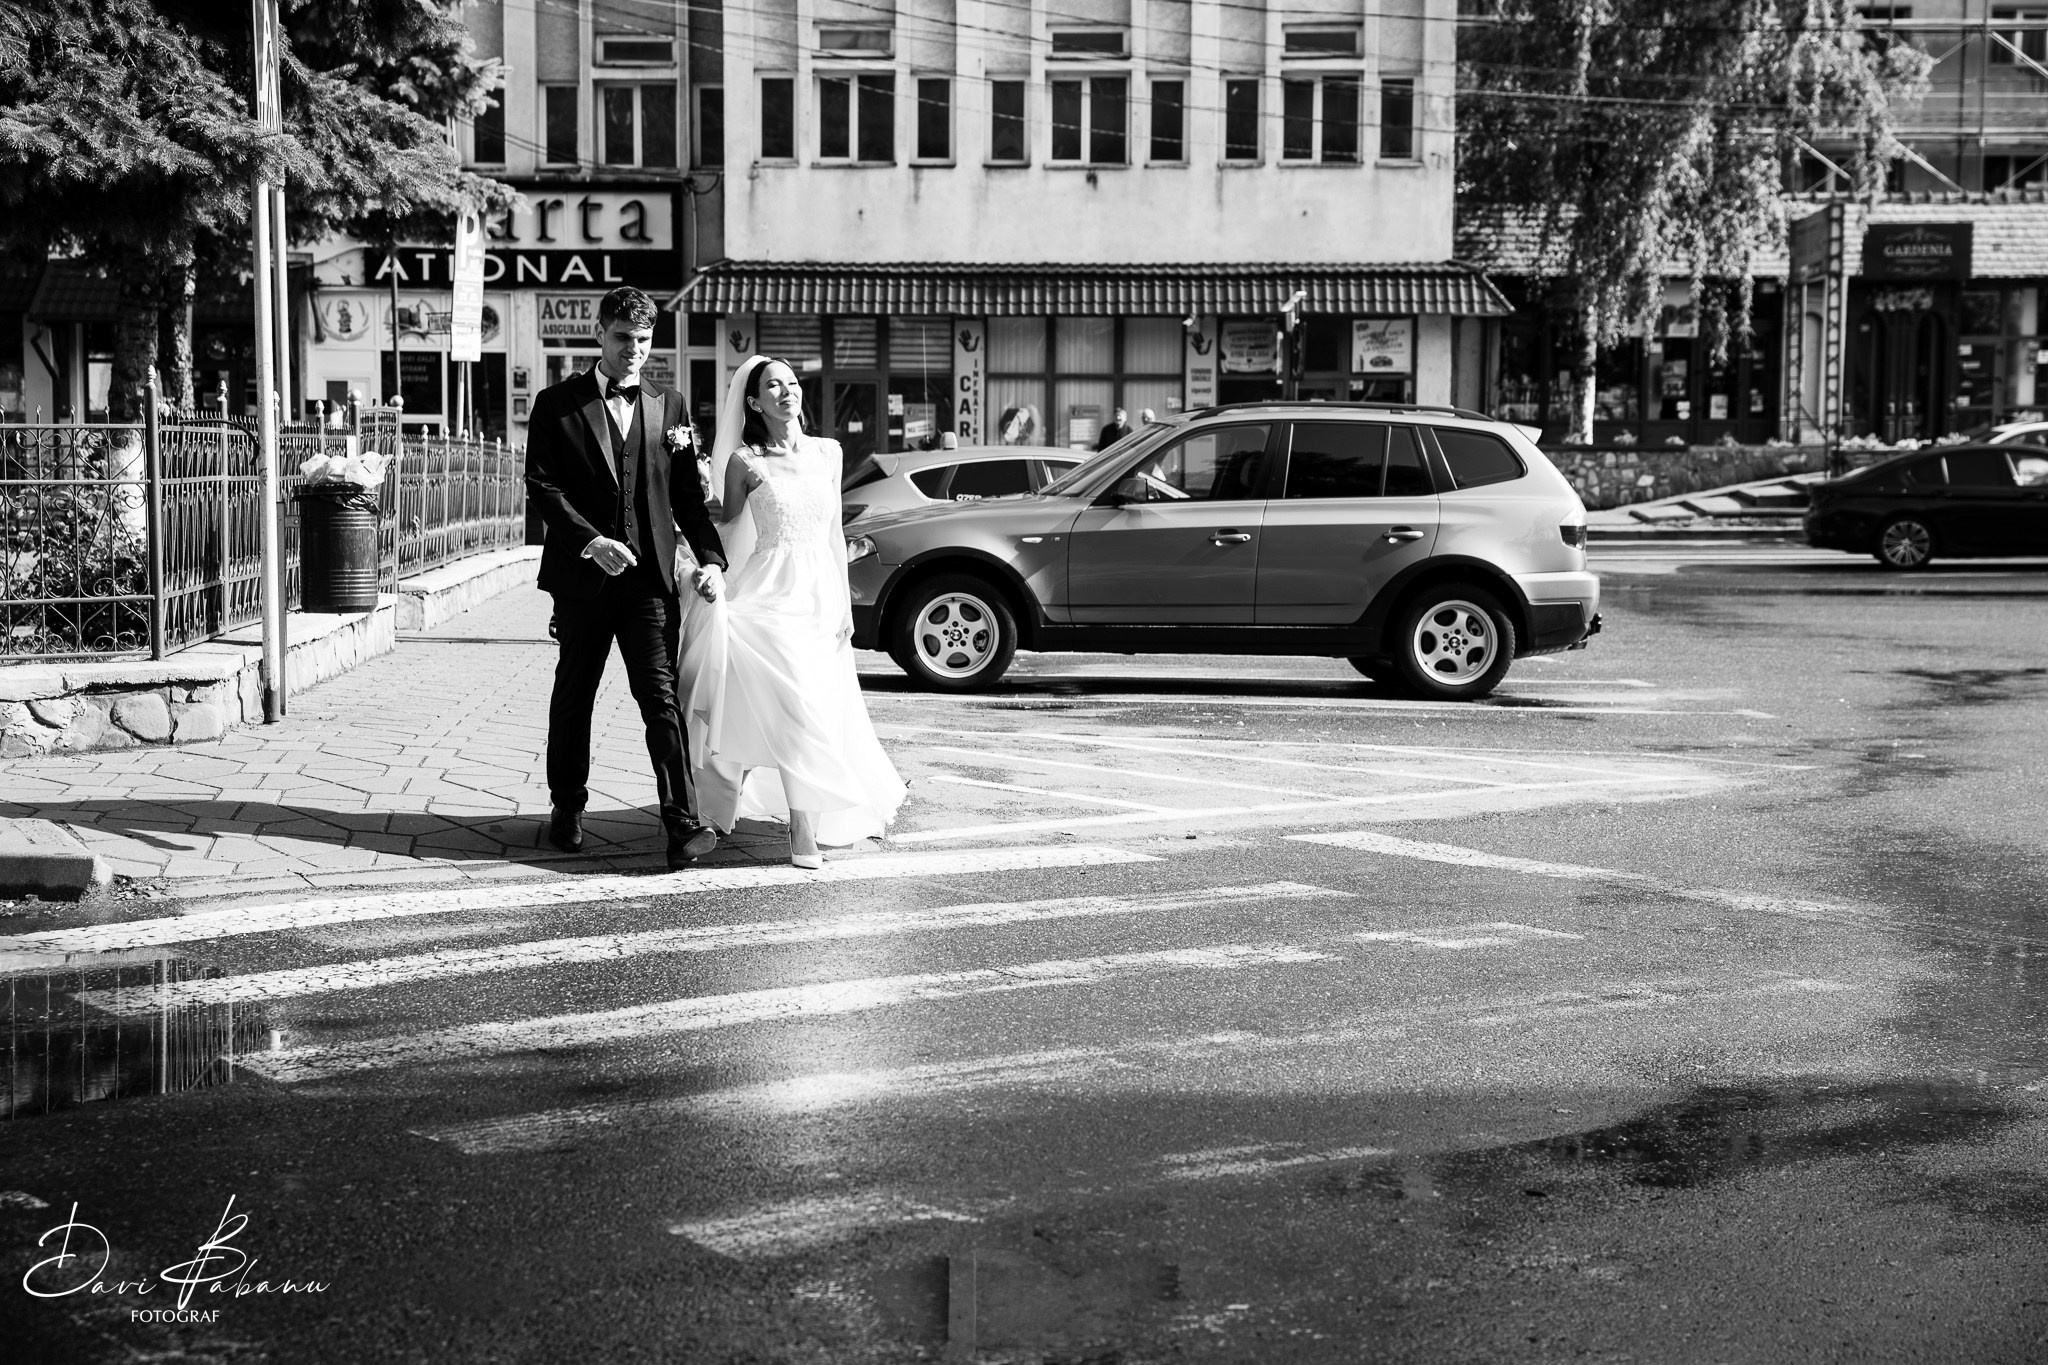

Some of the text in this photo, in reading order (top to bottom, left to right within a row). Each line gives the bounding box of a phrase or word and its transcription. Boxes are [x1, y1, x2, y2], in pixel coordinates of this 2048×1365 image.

[1883, 244, 1953, 257] GARDENIA
[541, 299, 592, 320] ACTE
[542, 324, 592, 336] ASIGURARI
[959, 375, 973, 438] CAR
